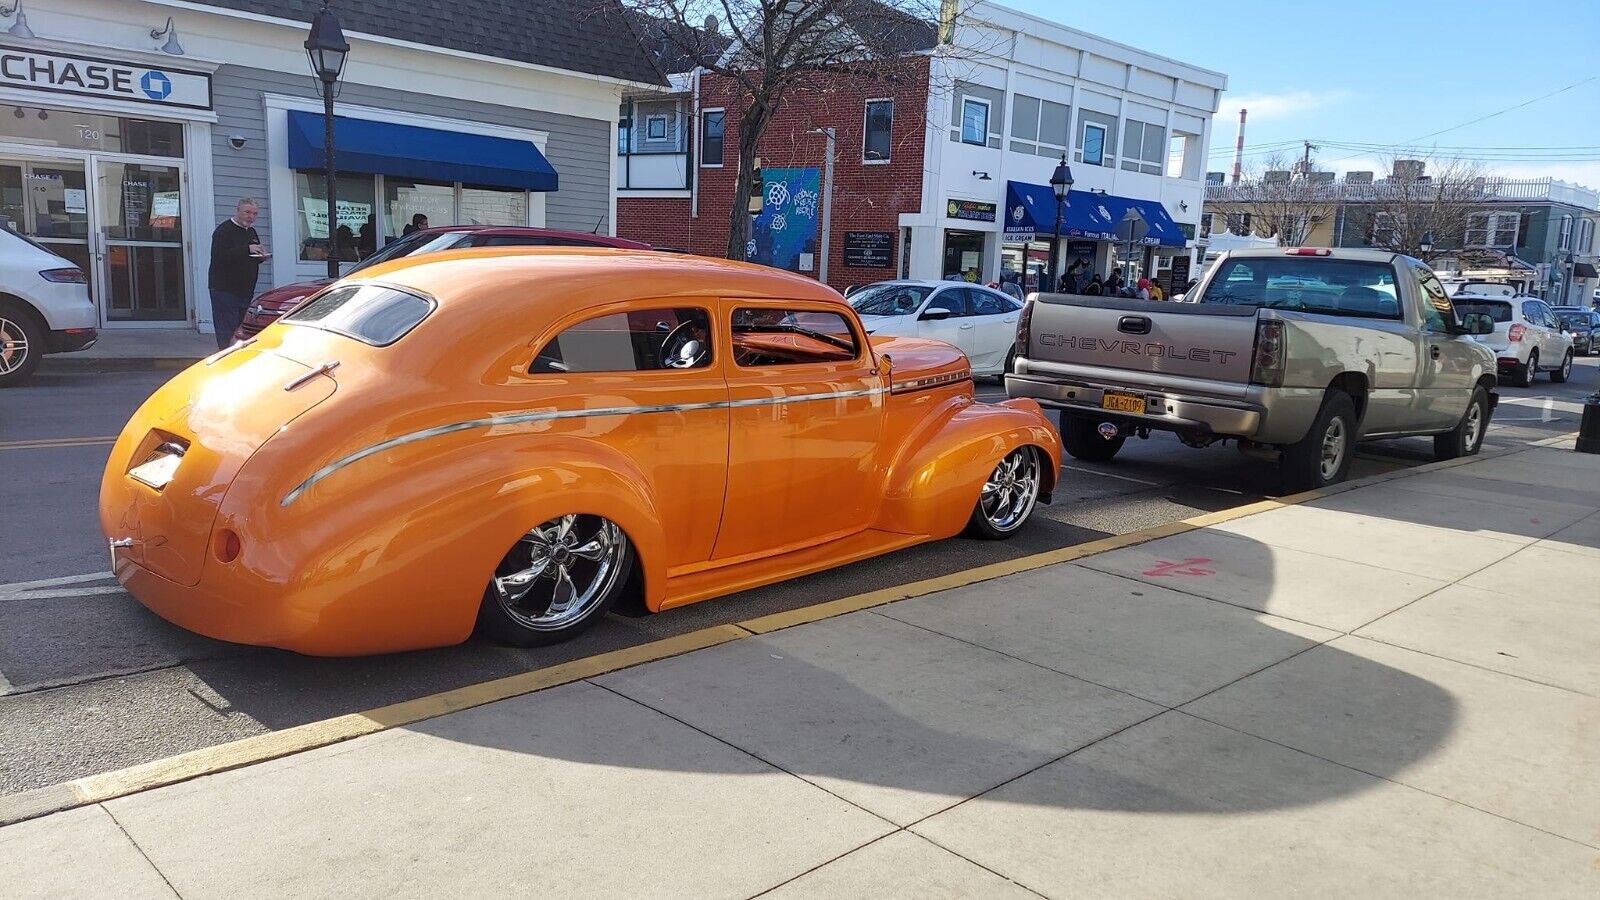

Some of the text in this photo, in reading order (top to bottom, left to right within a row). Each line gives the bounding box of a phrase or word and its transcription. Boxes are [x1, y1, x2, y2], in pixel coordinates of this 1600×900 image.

[1, 54, 134, 93] CHASE
[79, 129, 100, 140] 120
[24, 173, 51, 181] CHASE
[123, 180, 148, 188] CHASE
[1144, 236, 1161, 245] CREAM
[1039, 332, 1237, 364] CHEVROLET
